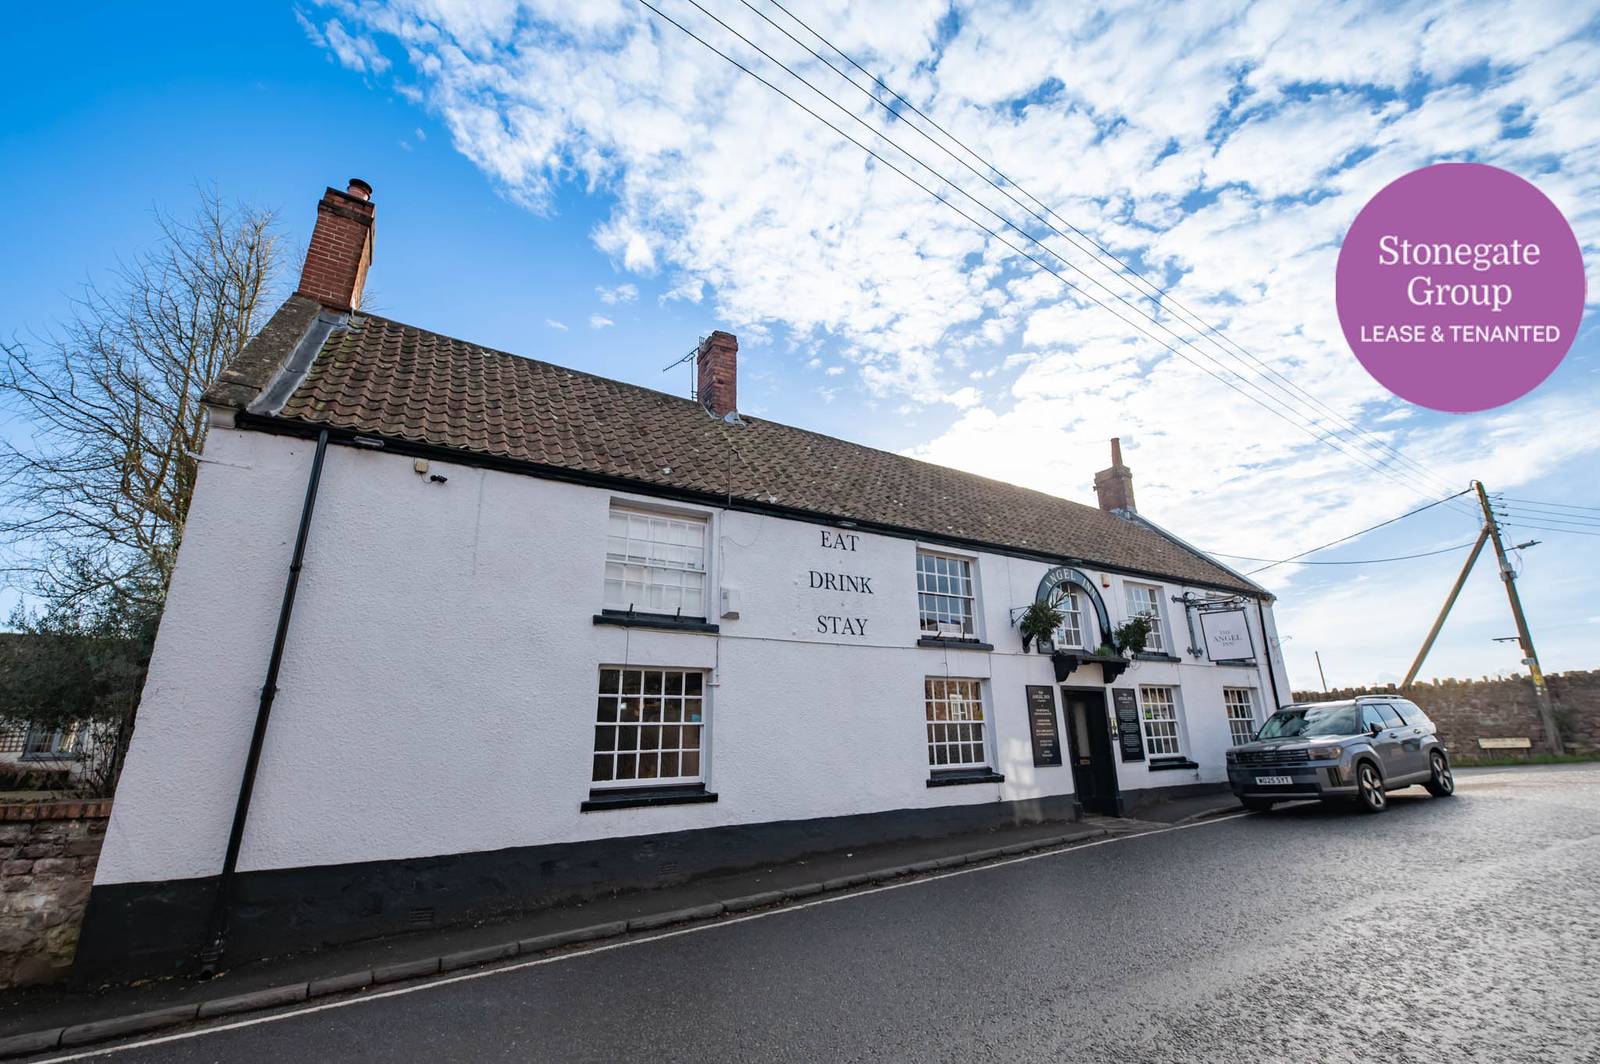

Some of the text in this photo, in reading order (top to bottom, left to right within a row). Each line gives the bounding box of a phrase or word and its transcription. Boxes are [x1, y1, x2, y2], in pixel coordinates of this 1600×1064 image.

[820, 530, 860, 552] EAT
[809, 570, 874, 595] DRINK
[1044, 568, 1099, 600] ANGEL INN
[817, 615, 869, 637] STAY
[1213, 634, 1243, 643] ANGEL
